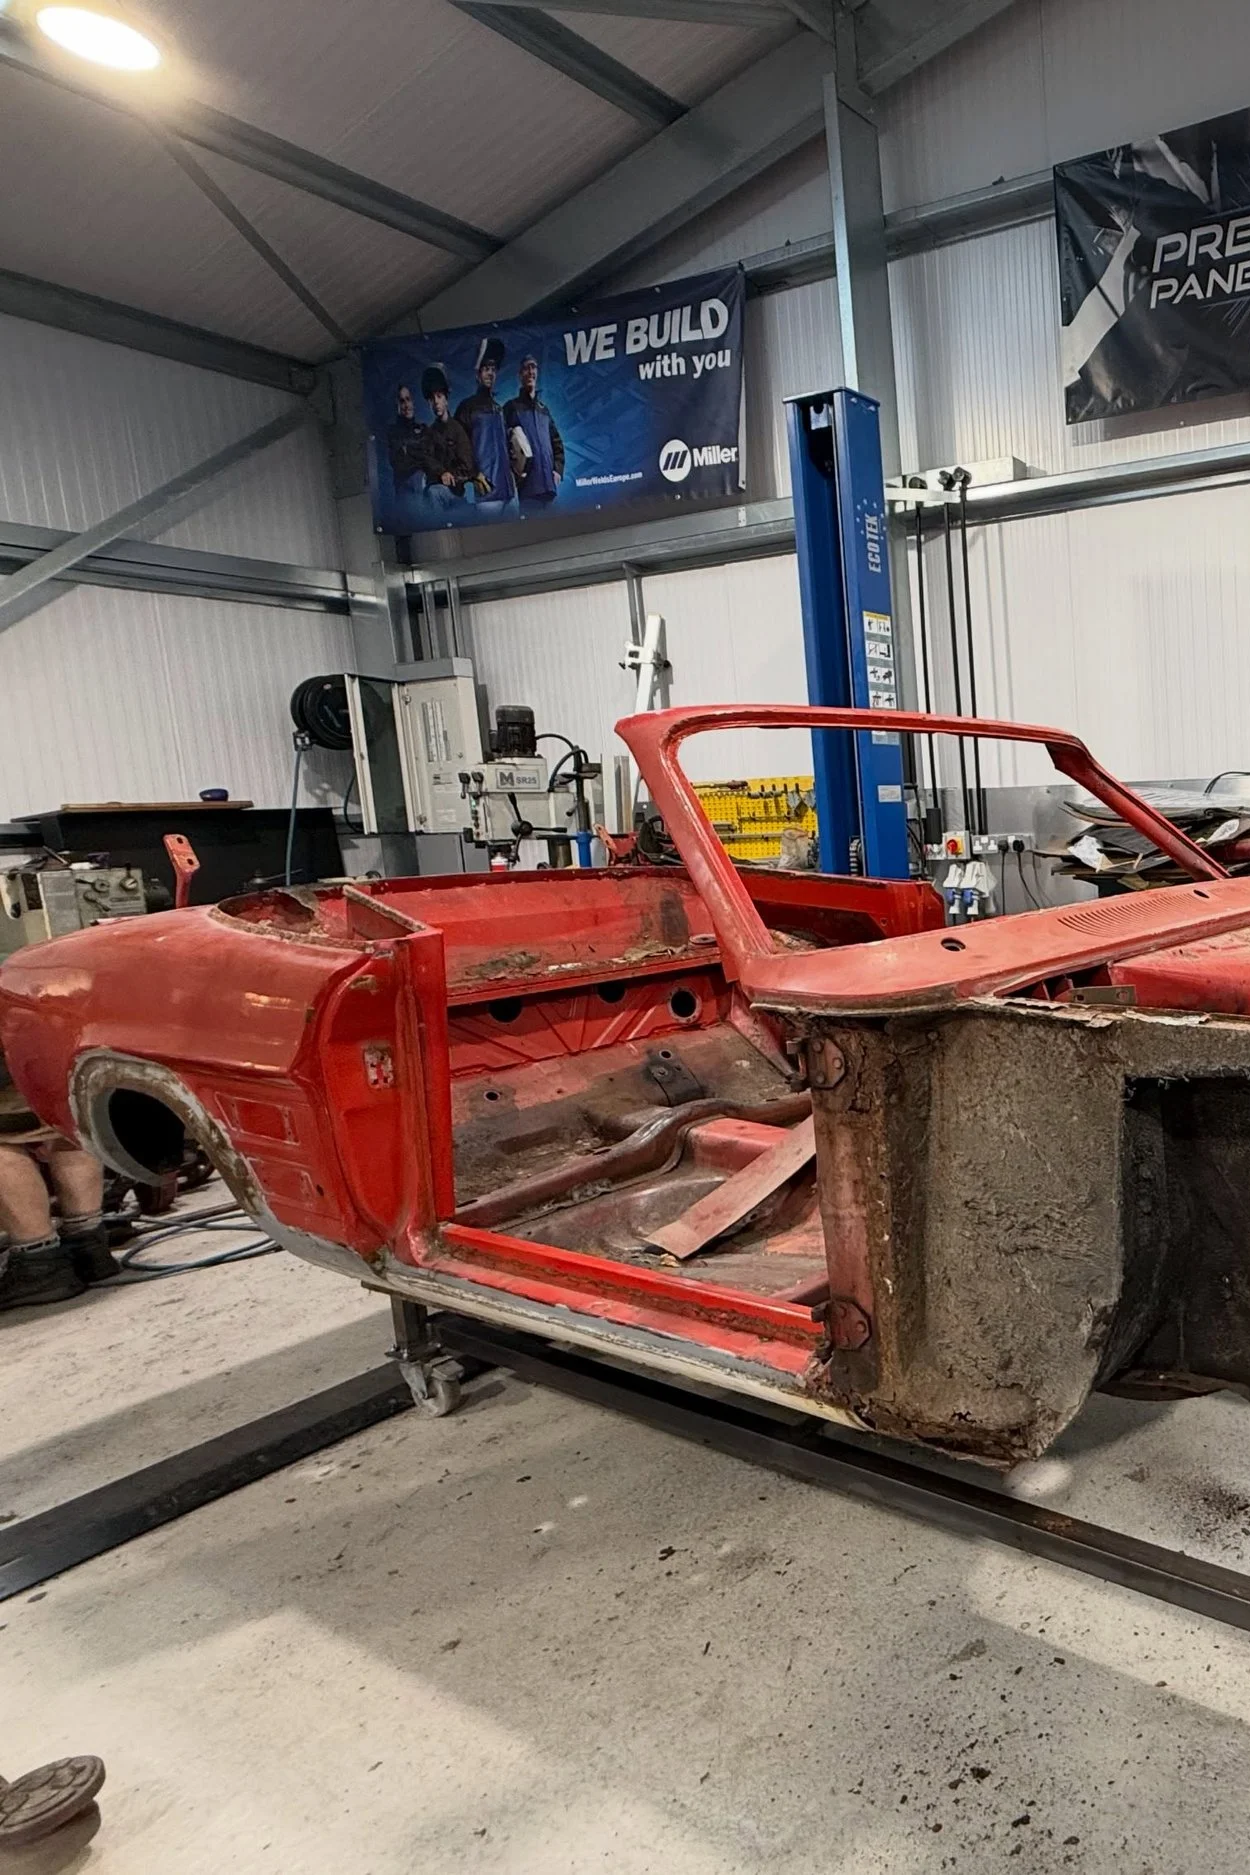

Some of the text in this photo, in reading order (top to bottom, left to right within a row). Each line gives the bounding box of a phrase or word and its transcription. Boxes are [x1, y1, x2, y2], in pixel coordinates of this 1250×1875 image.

[563, 298, 729, 366] WE BUILD
[638, 349, 731, 380] with you
[692, 445, 738, 468] Miller
[864, 512, 882, 574] ECOTEK
[515, 775, 538, 785] SR25
